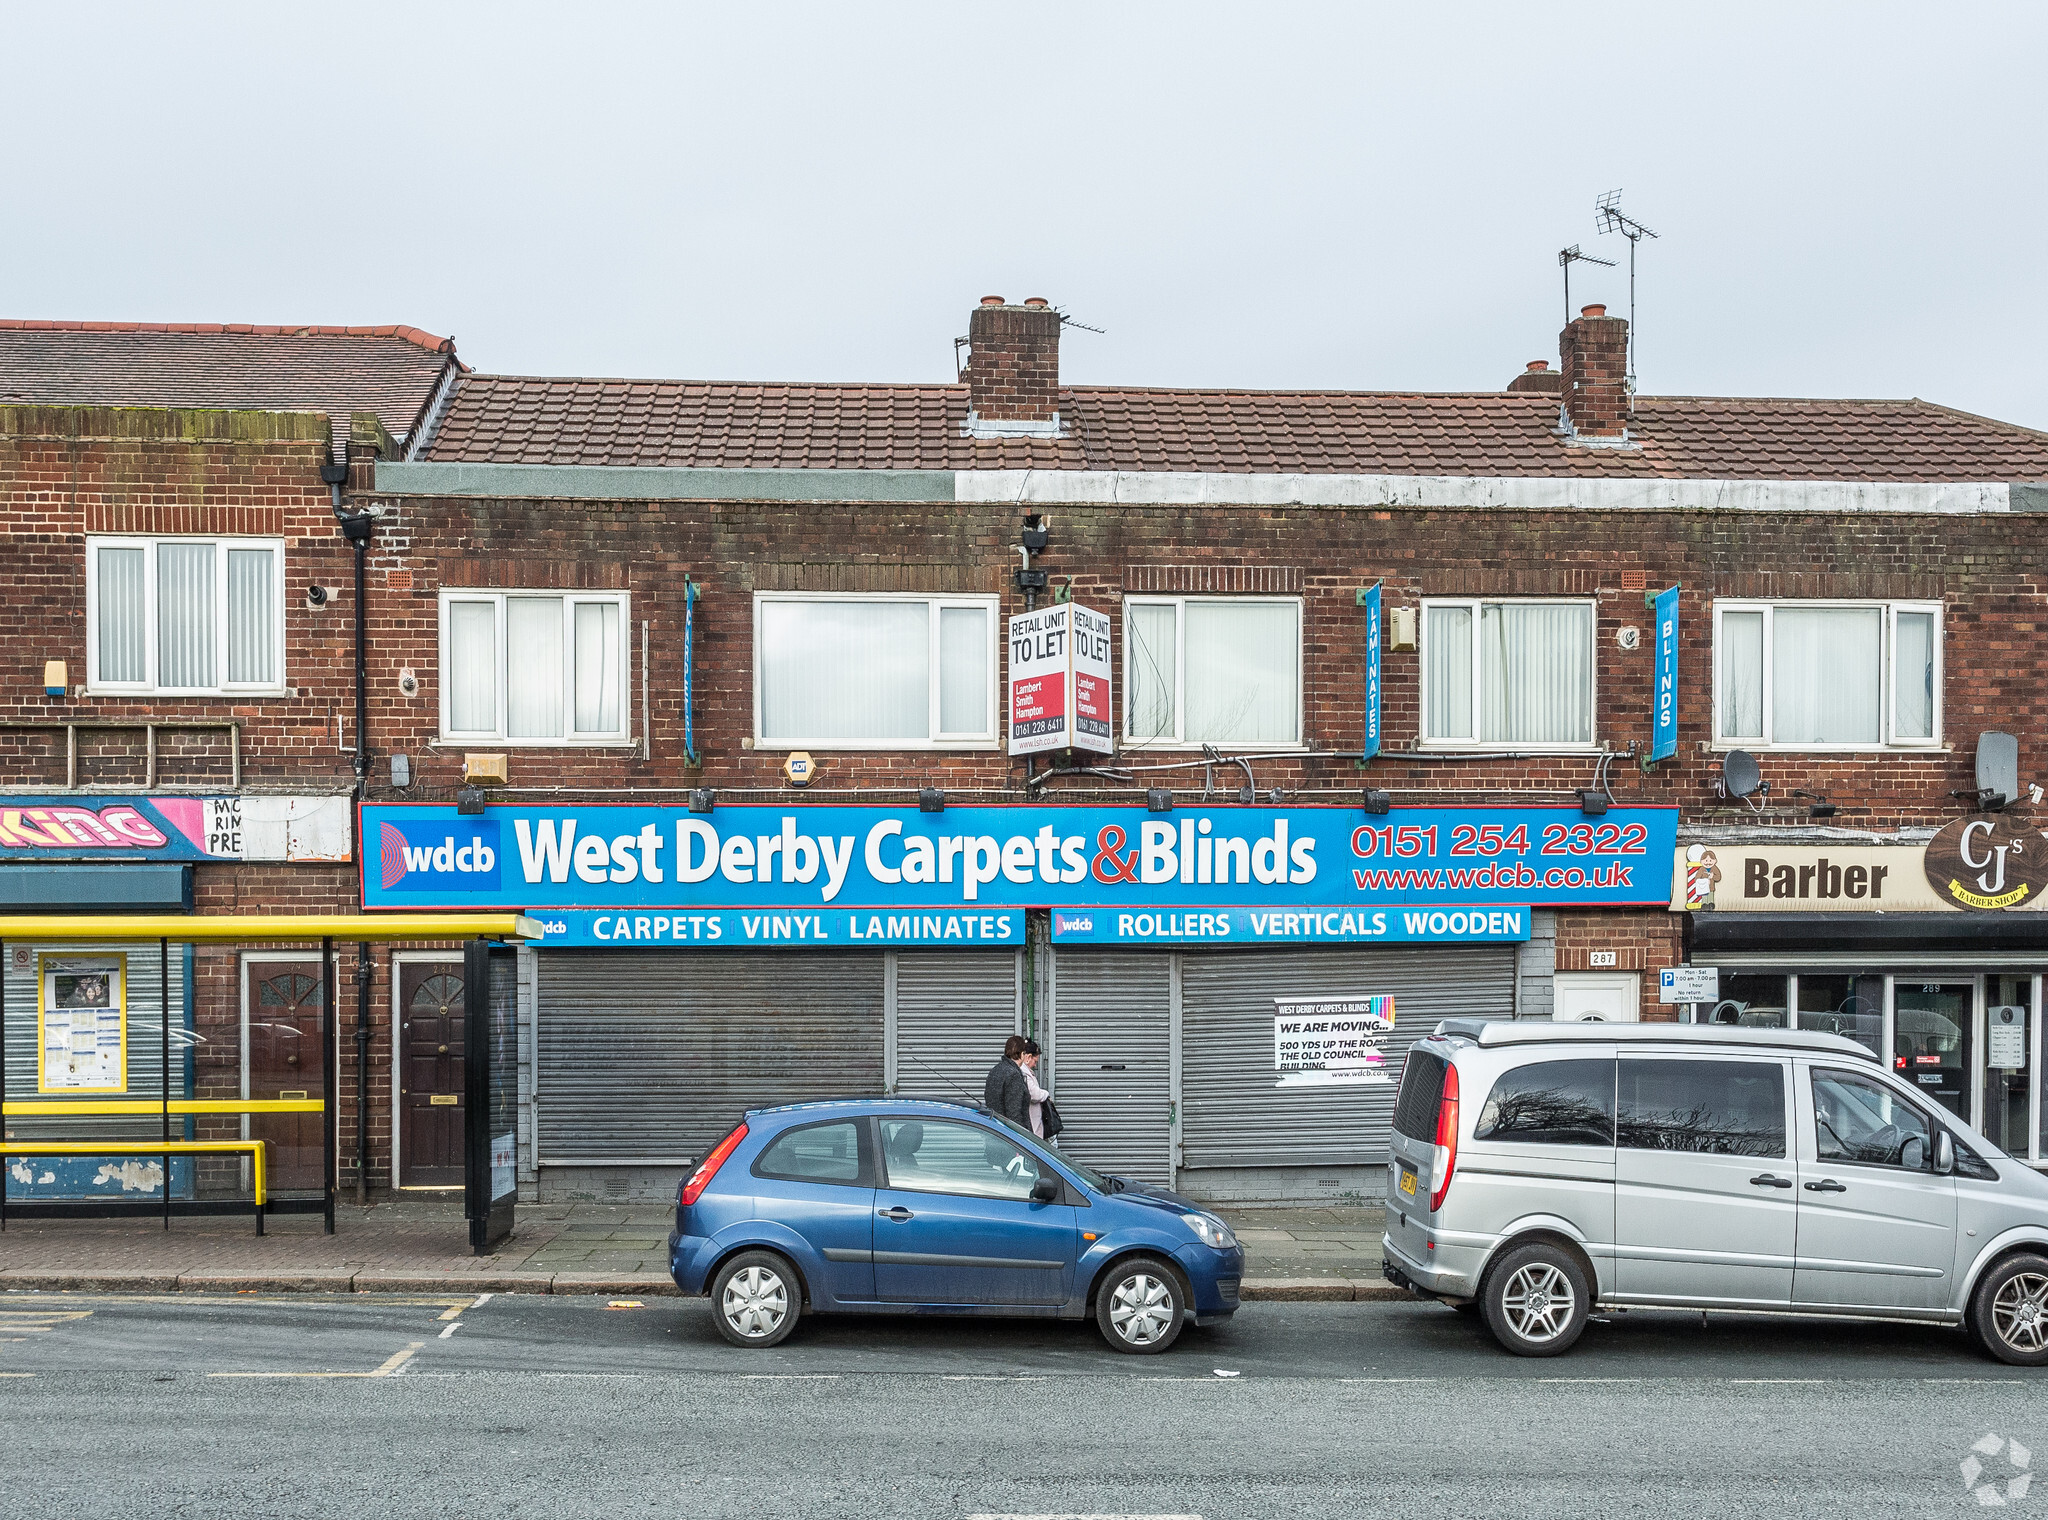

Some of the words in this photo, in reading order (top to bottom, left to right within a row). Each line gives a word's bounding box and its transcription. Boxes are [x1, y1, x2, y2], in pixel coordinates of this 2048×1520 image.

[1012, 617, 1042, 637] RETAIL
[1044, 611, 1066, 629] UNIT
[1075, 611, 1093, 628] RETAIL
[1094, 617, 1109, 636] UNIT
[1012, 638, 1031, 664] TO
[1036, 630, 1066, 660] LET
[1075, 630, 1088, 656] TO
[1090, 636, 1109, 663] LET
[1368, 607, 1378, 738] LAMINATES
[1660, 619, 1673, 727] BLINDS
[1016, 681, 1042, 695] Lambert
[1077, 676, 1095, 691] Lambert
[1016, 694, 1034, 707] Smith
[1077, 689, 1091, 702] Smith
[1016, 705, 1043, 719] Hampton
[1077, 700, 1097, 715] Hampton
[1015, 723, 1030, 737] 0161
[1032, 720, 1045, 733] 228
[1047, 717, 1063, 731] 6411
[1018, 736, 1059, 749] www.lsh.co.uk
[792, 762, 807, 771] ADT
[1351, 824, 1438, 857] 0151
[1450, 823, 1531, 856] 254
[1541, 823, 1648, 855] 2322
[402, 836, 495, 874] wdcb
[514, 819, 665, 884] West
[676, 817, 855, 902] Derby
[864, 818, 1087, 900] Carpets
[1092, 824, 1139, 884] &
[1141, 817, 1317, 885] Blinds
[1352, 861, 1635, 890] www.wdcb.co.uk
[1744, 858, 1888, 899] Barber
[1958, 890, 1993, 907] BARBER
[1995, 892, 2018, 906] SHOP
[592, 916, 722, 940] CARPETS
[741, 916, 828, 939] VINYL
[850, 915, 1012, 939] LAMINATES
[1062, 917, 1093, 931] wdcb
[1118, 913, 1231, 937] ROLLERS
[1250, 913, 1386, 936] VERTICALS
[1404, 912, 1521, 935] WOODEN
[1593, 954, 1613, 964] 287
[1922, 984, 1941, 993] 289
[1278, 1005, 1296, 1014] WEST
[1296, 1005, 1315, 1014] DERBY
[1316, 1004, 1341, 1013] CARPETS
[1342, 1004, 1348, 1012] &
[1348, 1003, 1370, 1012] BLINDS
[1280, 1023, 1301, 1034] WE
[1302, 1022, 1328, 1033] ARE
[1330, 1021, 1389, 1032] MOVING...
[1279, 1041, 1299, 1050] 500
[1301, 1041, 1321, 1049] YDS
[1322, 1040, 1336, 1049] UP
[1338, 1040, 1358, 1048] THE
[1280, 1053, 1299, 1061] THE
[1301, 1052, 1321, 1060] OLD
[1323, 1050, 1366, 1059] COUNCIL
[1280, 1061, 1326, 1070] BUILDING
[1331, 1070, 1390, 1078] www.wdcb.co.u
